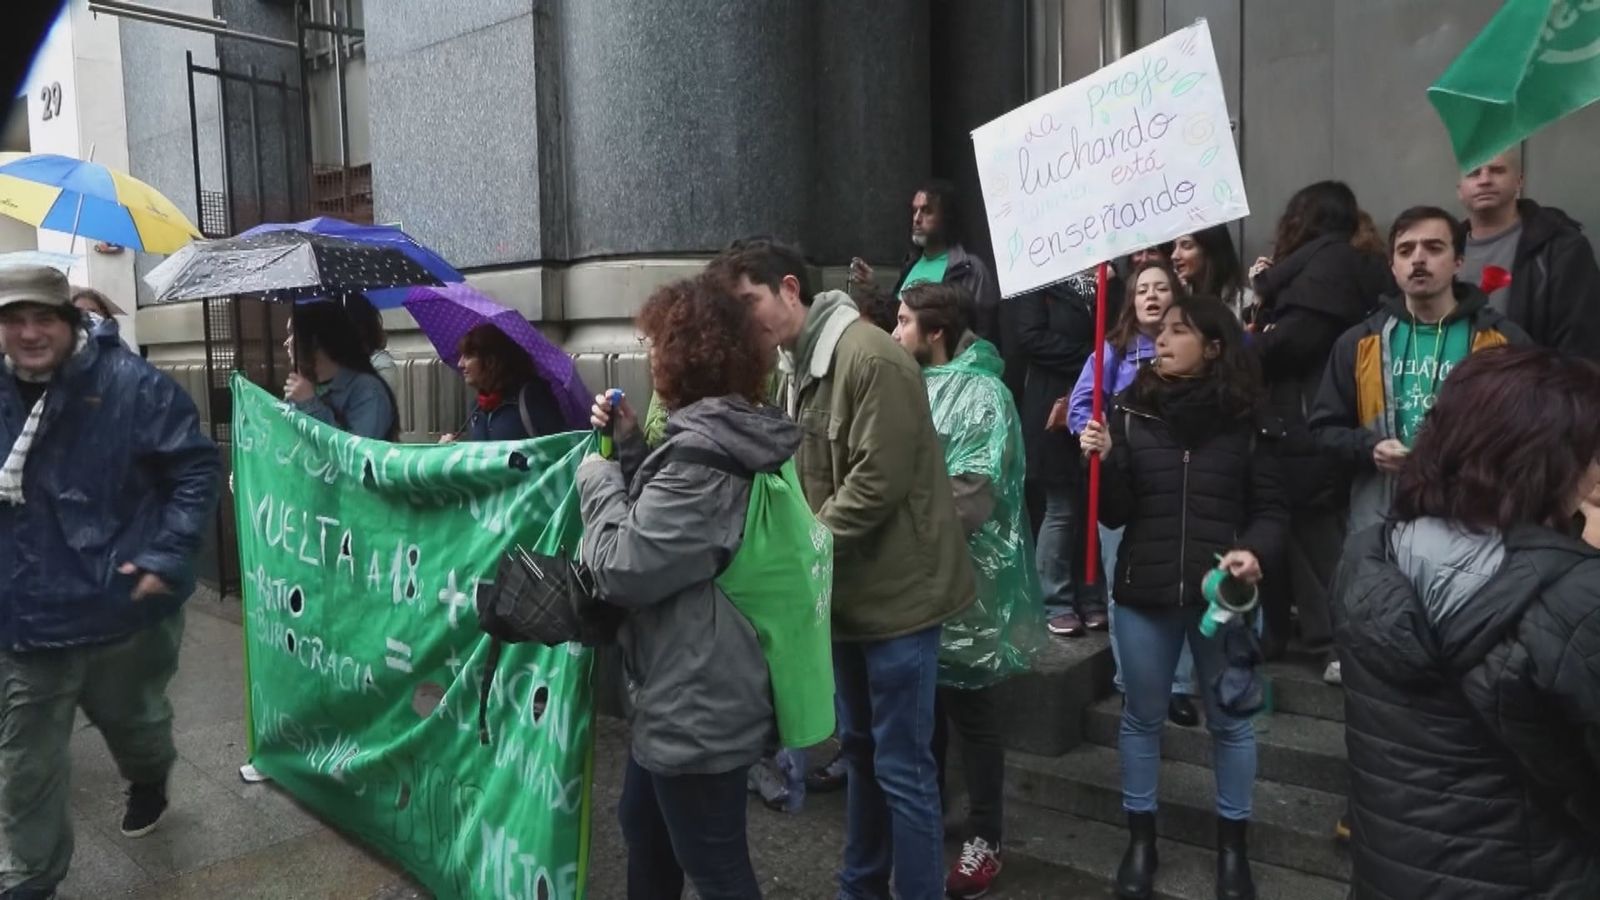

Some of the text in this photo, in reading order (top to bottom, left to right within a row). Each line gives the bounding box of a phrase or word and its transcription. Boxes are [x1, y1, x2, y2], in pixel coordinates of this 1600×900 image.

[41, 81, 62, 121] 29
[1087, 56, 1176, 127] profe
[1018, 107, 1177, 195] luchando
[1111, 149, 1166, 185] está
[1028, 174, 1196, 267] enseñando
[248, 489, 354, 581] VUELTA
[367, 551, 381, 592] A
[390, 538, 421, 606] 18
